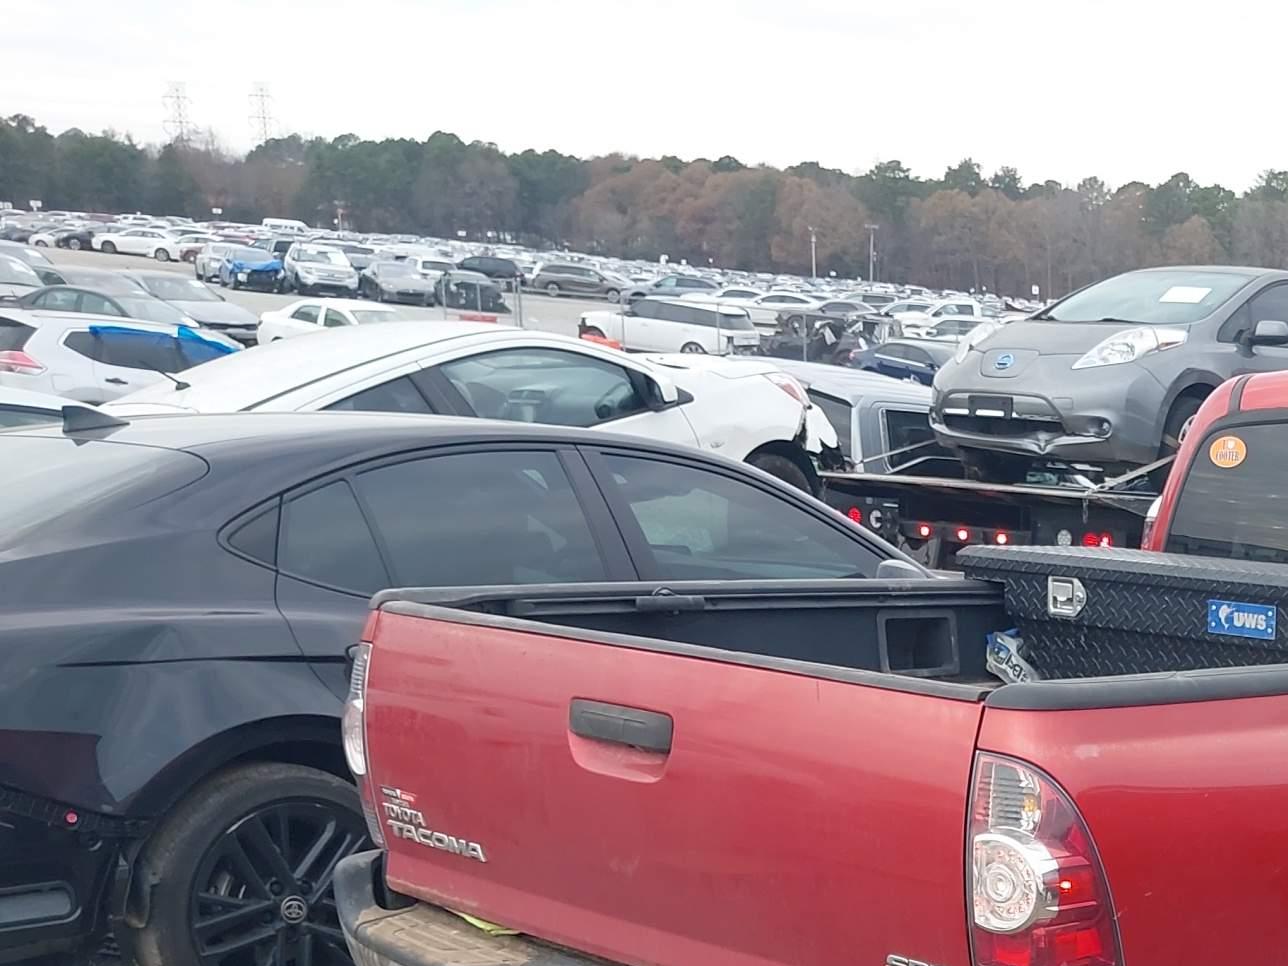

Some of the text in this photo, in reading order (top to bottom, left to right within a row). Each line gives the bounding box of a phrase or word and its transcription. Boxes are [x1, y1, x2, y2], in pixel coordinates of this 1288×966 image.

[1233, 611, 1267, 631] UWS
[382, 802, 426, 826] TOYOTA
[386, 819, 487, 862] TACOMA
